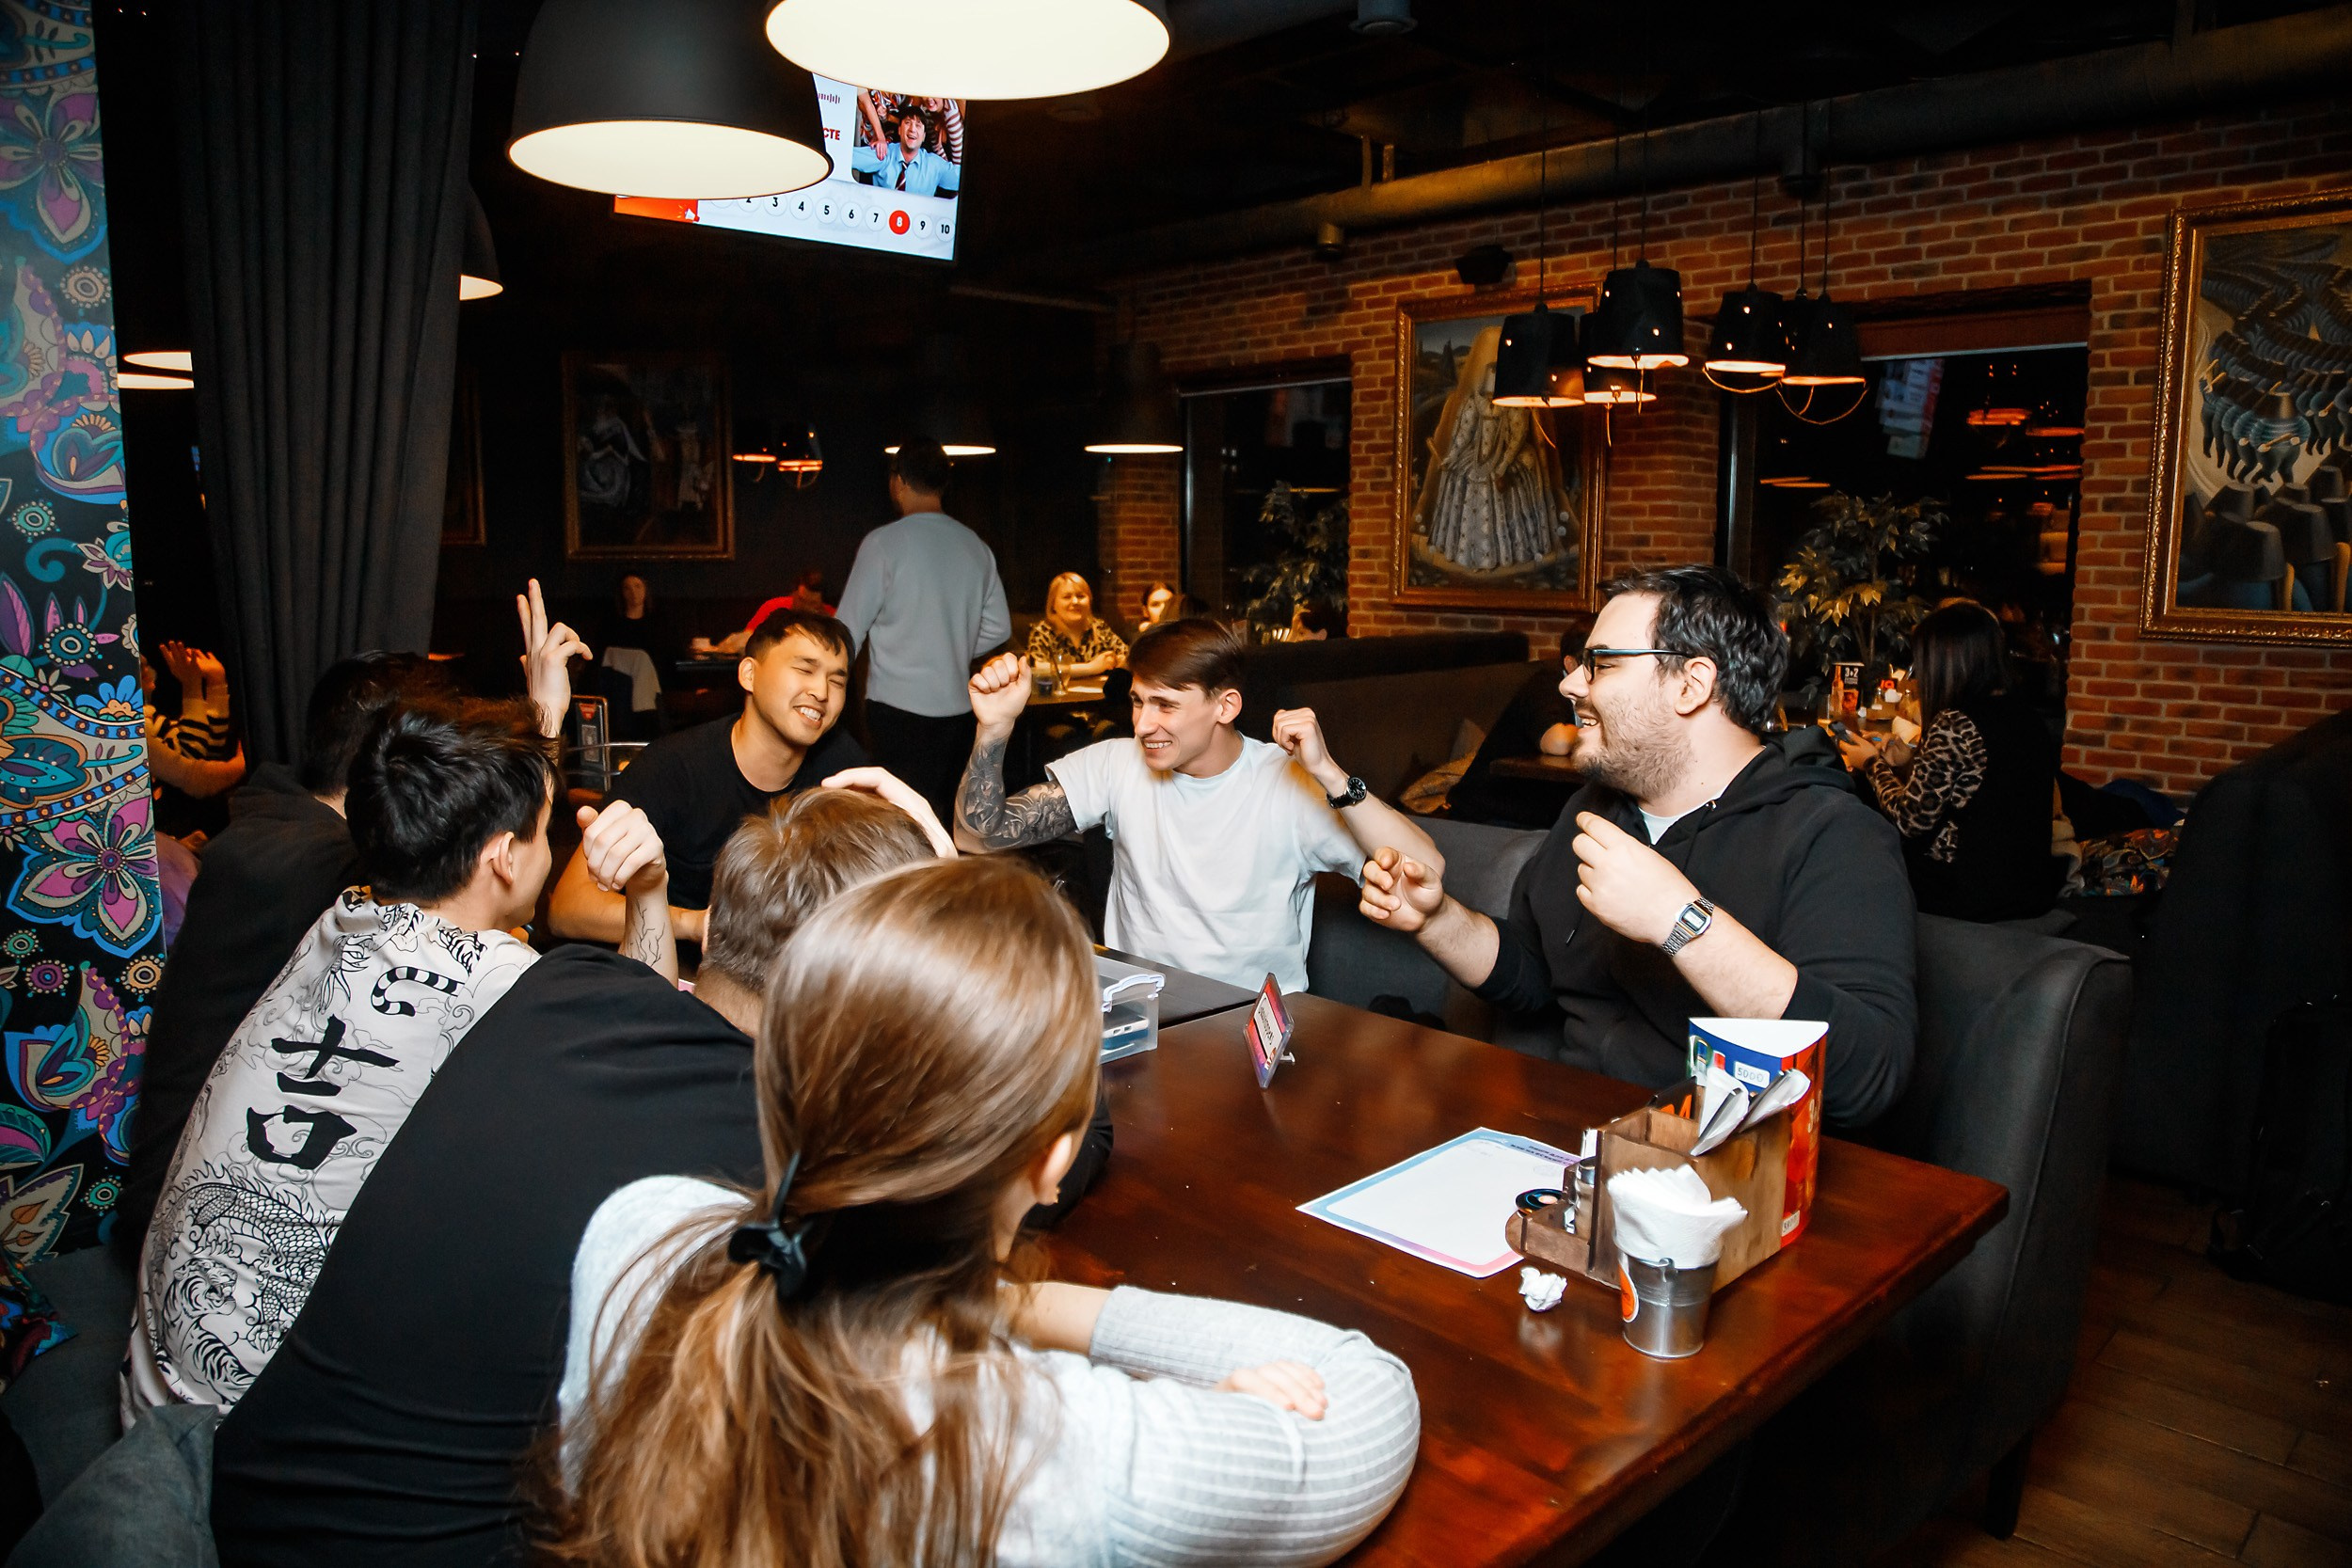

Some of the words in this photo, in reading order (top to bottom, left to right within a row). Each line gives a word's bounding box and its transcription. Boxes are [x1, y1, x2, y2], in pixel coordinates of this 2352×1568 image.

[772, 197, 778, 207] 3
[798, 201, 804, 212] 4
[824, 205, 830, 215] 5
[849, 209, 854, 219] 6
[873, 213, 879, 223] 7
[896, 216, 903, 228] 8
[920, 220, 926, 230] 9
[941, 224, 950, 234] 10
[1737, 1067, 1764, 1083] 5000
